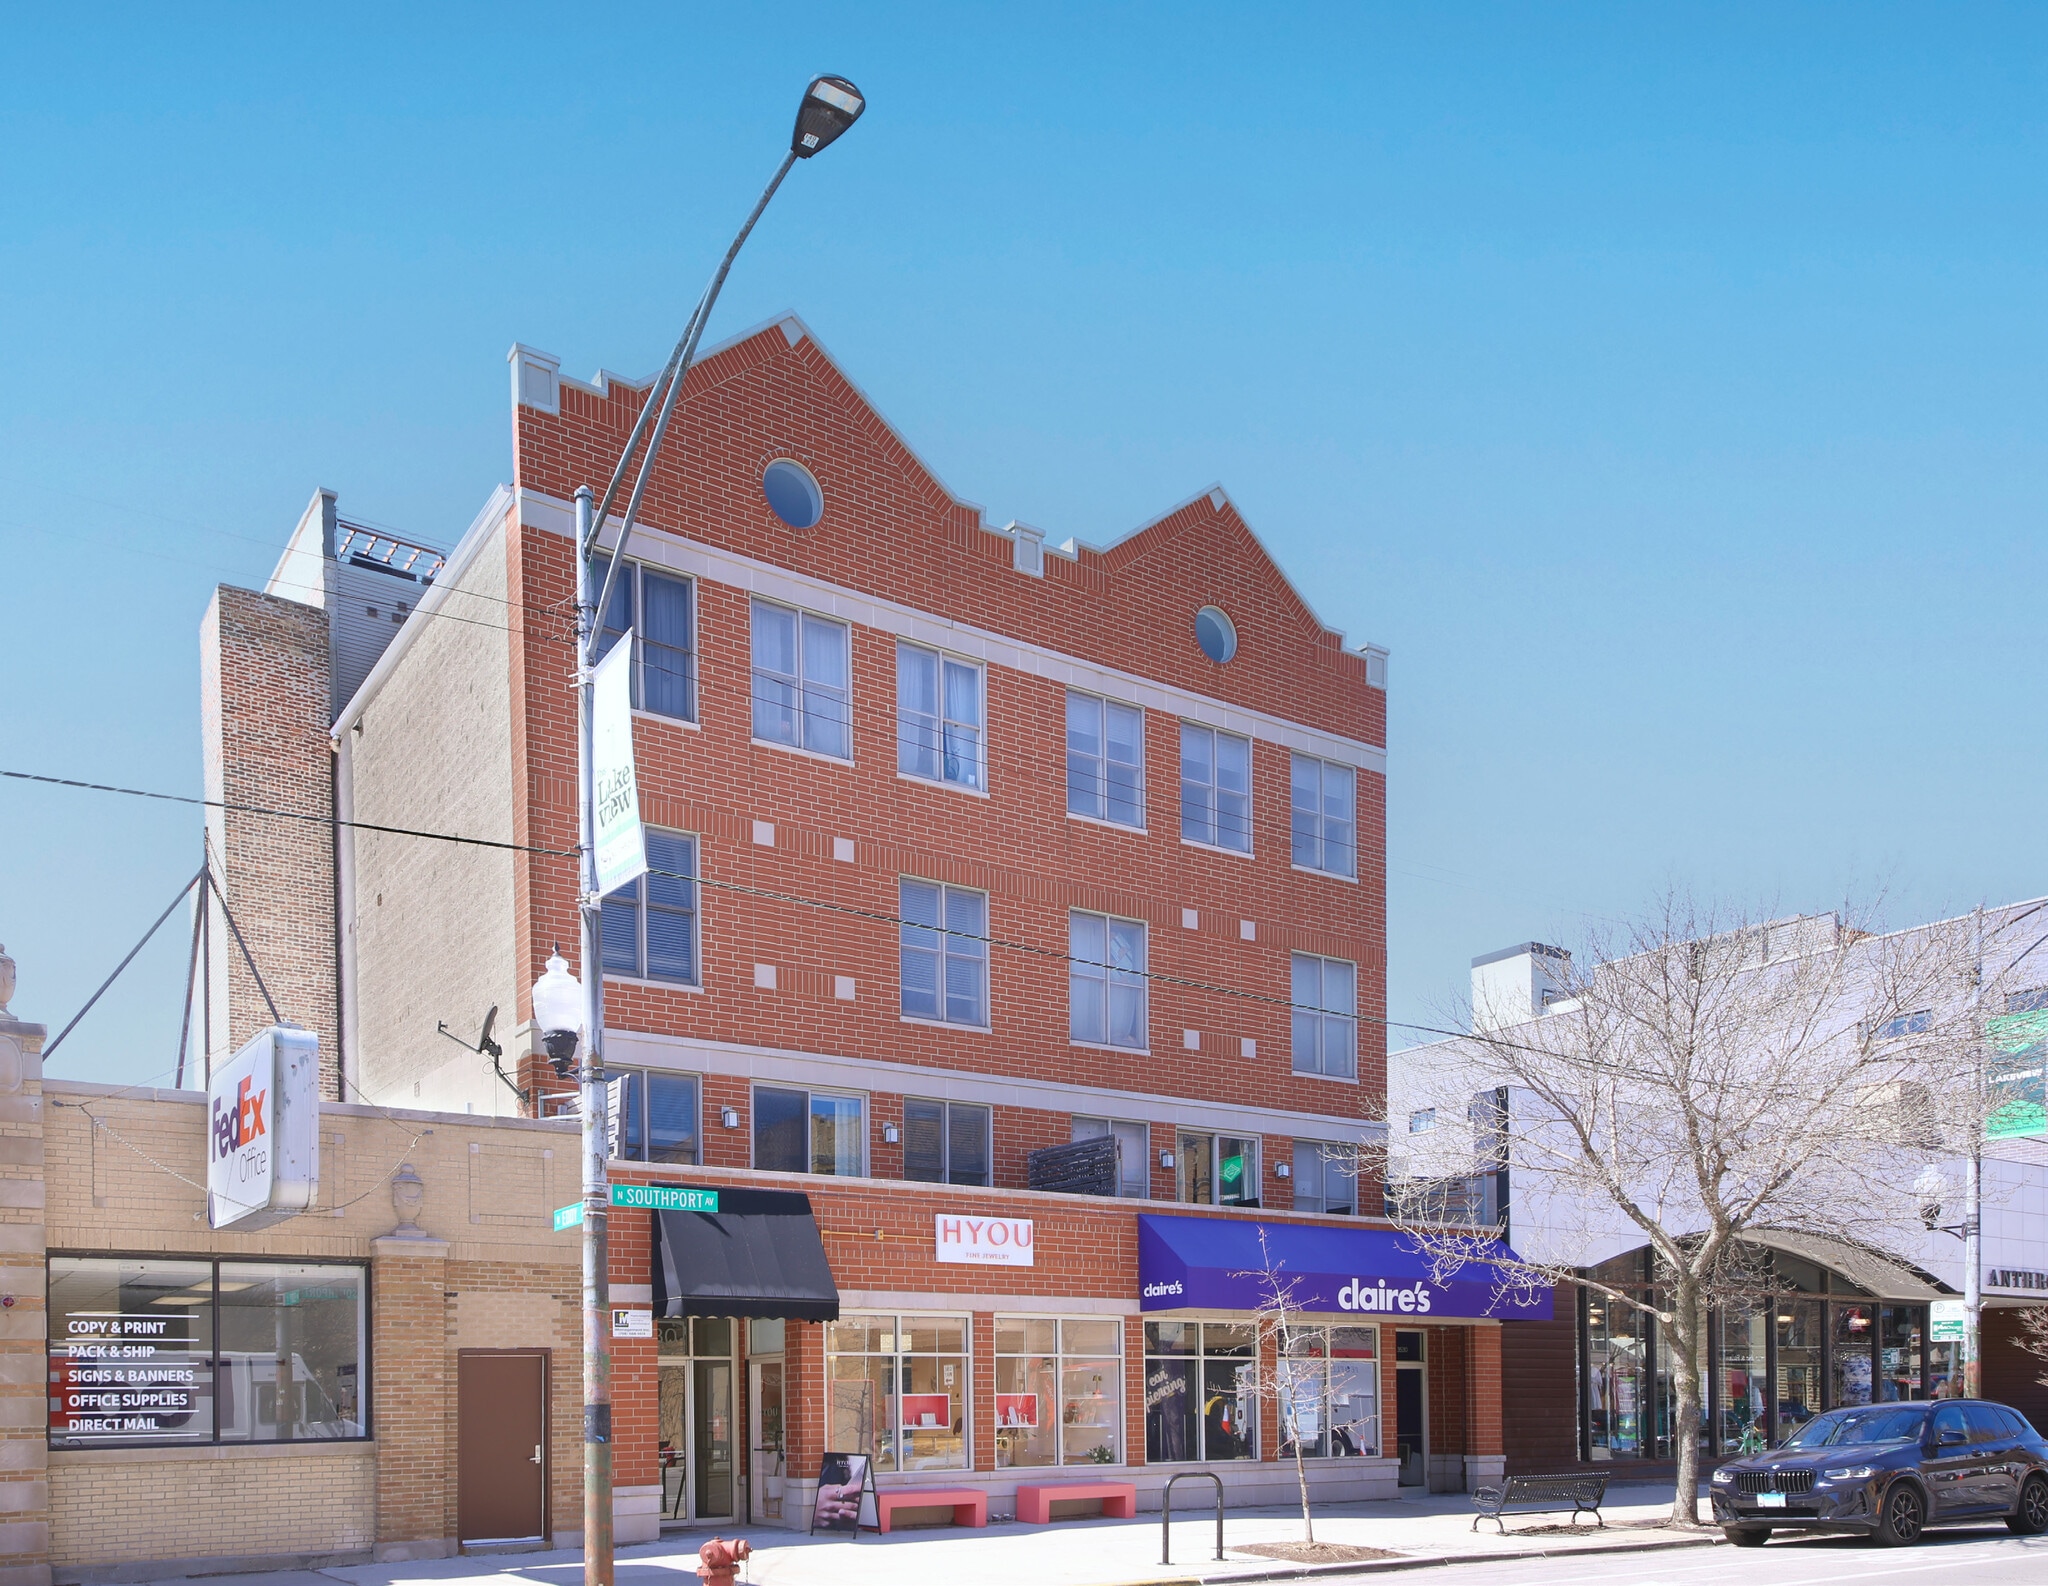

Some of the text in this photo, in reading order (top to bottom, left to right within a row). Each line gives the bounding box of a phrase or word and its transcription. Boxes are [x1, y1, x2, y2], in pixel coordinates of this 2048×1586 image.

[1988, 1068, 2044, 1084] LAKEVIEW
[212, 1074, 267, 1163] FedEx
[239, 1147, 267, 1183] Office
[617, 1188, 714, 1208] N SOUTHPORT AV
[943, 1219, 1033, 1247] HYOU
[1987, 1269, 2048, 1290] ANTHR
[1143, 1280, 1183, 1298] claire's
[1337, 1277, 1431, 1313] claire's
[67, 1321, 166, 1334] COPY & PRINT
[68, 1346, 156, 1358] PACK & SHIP
[68, 1370, 194, 1382] SIGNS & BANNERS
[1148, 1369, 1169, 1387] ear
[68, 1393, 188, 1407] OFFICE SUPPLIES
[1146, 1377, 1186, 1413] piercing
[68, 1418, 160, 1431] DIRECT MAIL
